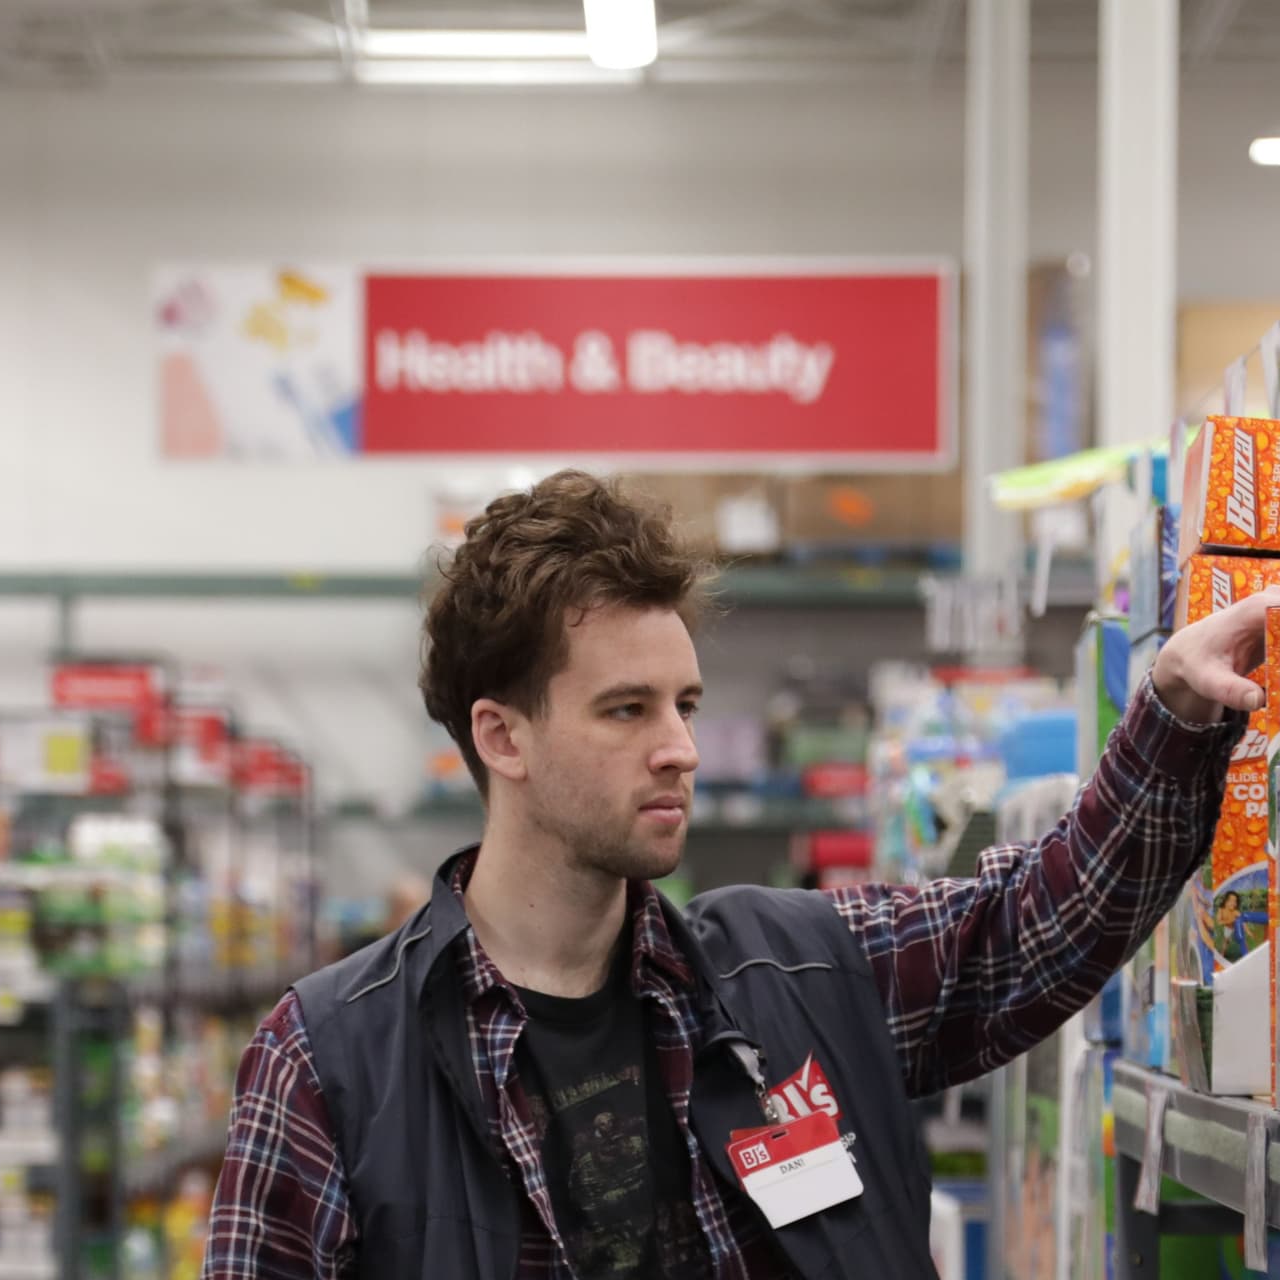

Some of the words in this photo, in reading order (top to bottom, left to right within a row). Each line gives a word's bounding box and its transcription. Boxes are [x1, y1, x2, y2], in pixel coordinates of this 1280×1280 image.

[375, 327, 565, 394] Health
[569, 329, 620, 395] &
[625, 329, 835, 404] Beauty
[1267, 500, 1280, 535] SLIDE
